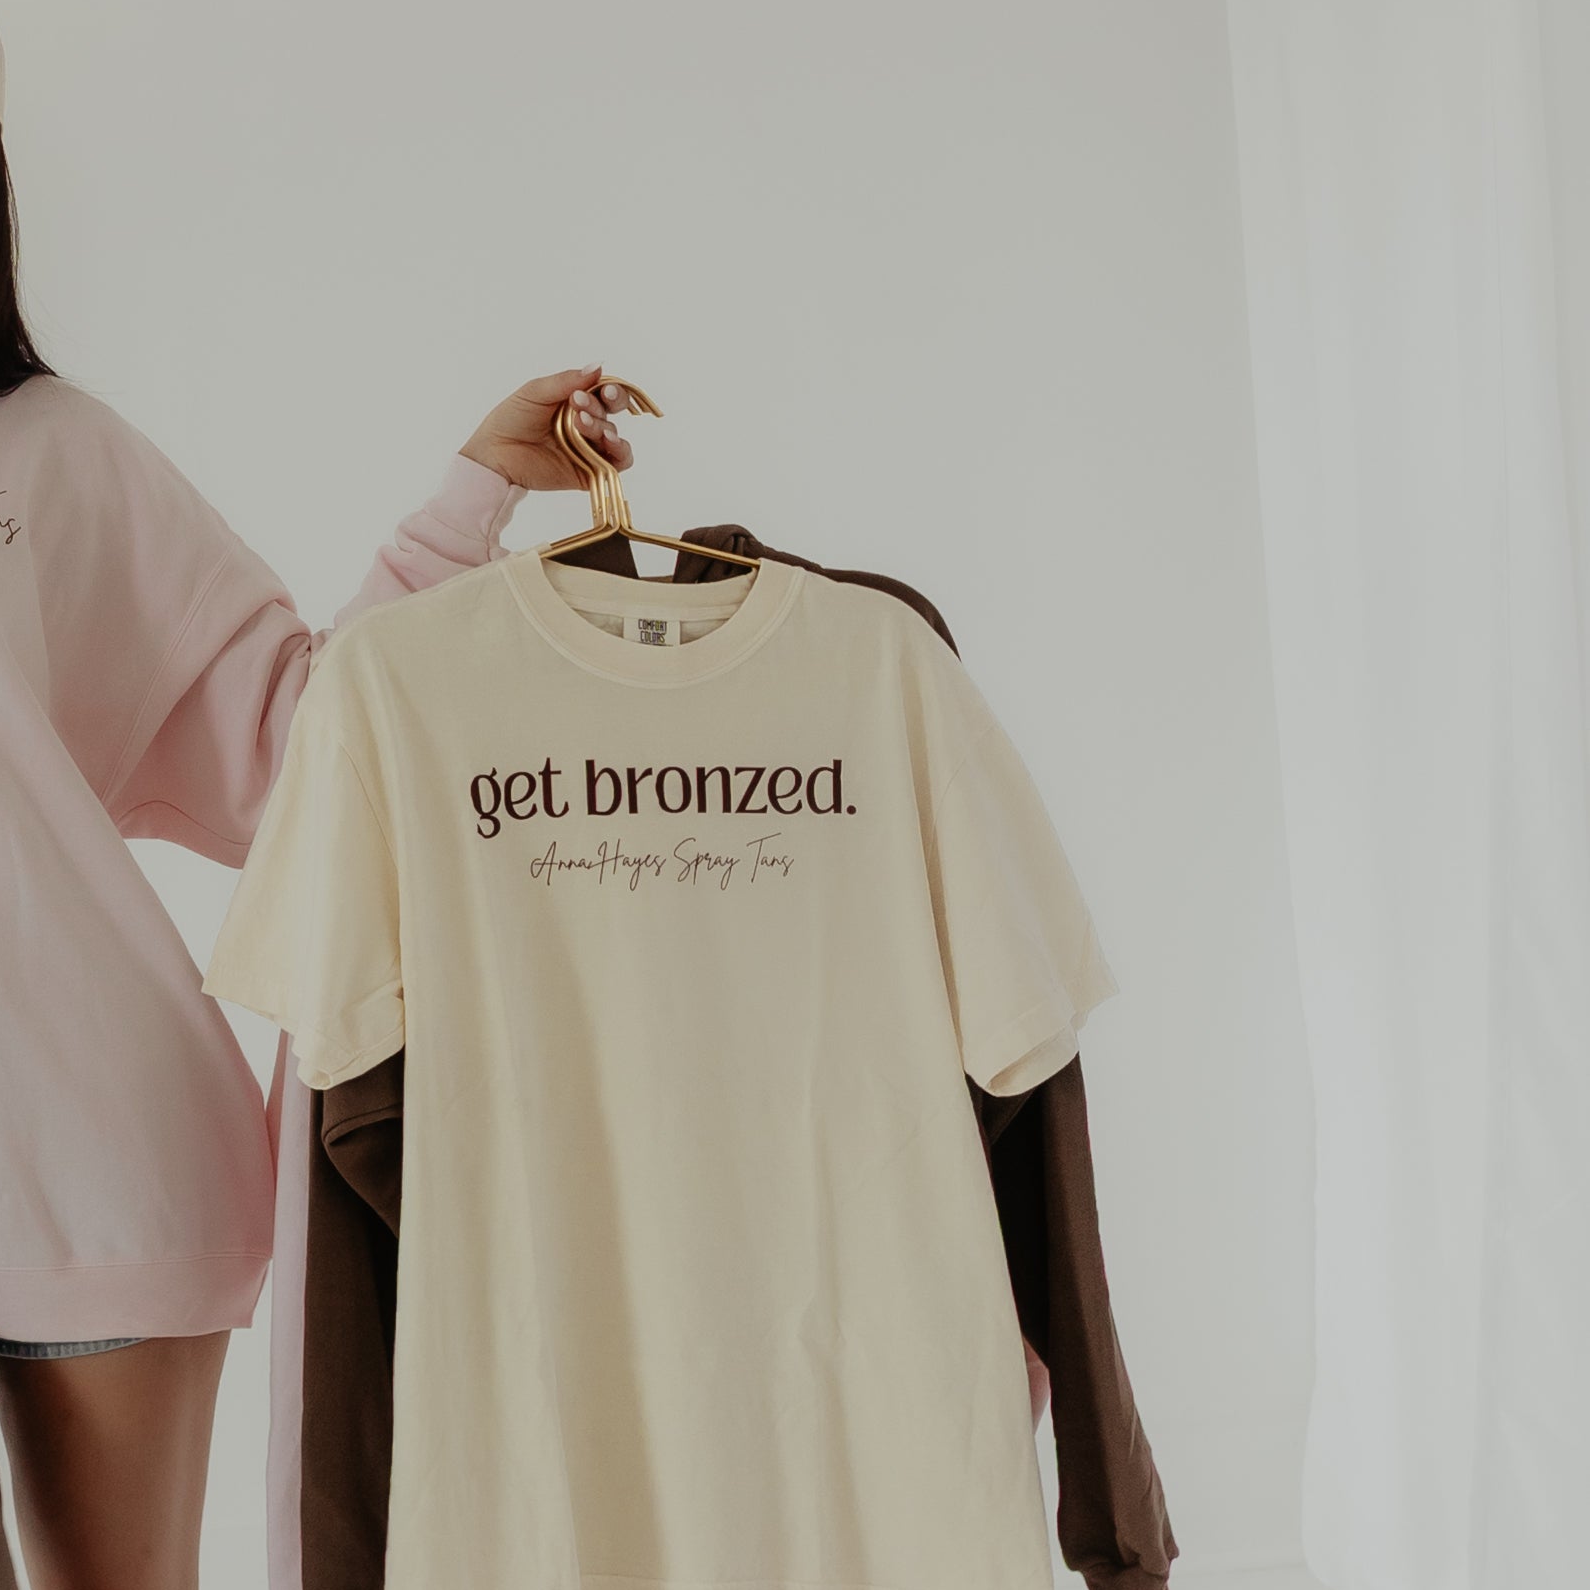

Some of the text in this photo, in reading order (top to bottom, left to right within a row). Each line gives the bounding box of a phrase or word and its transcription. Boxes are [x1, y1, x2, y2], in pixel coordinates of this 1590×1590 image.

[640, 630, 665, 643] COLORS
[470, 757, 857, 839] get bronzed.
[530, 832, 794, 891] AnnaHayes Spray Tans
